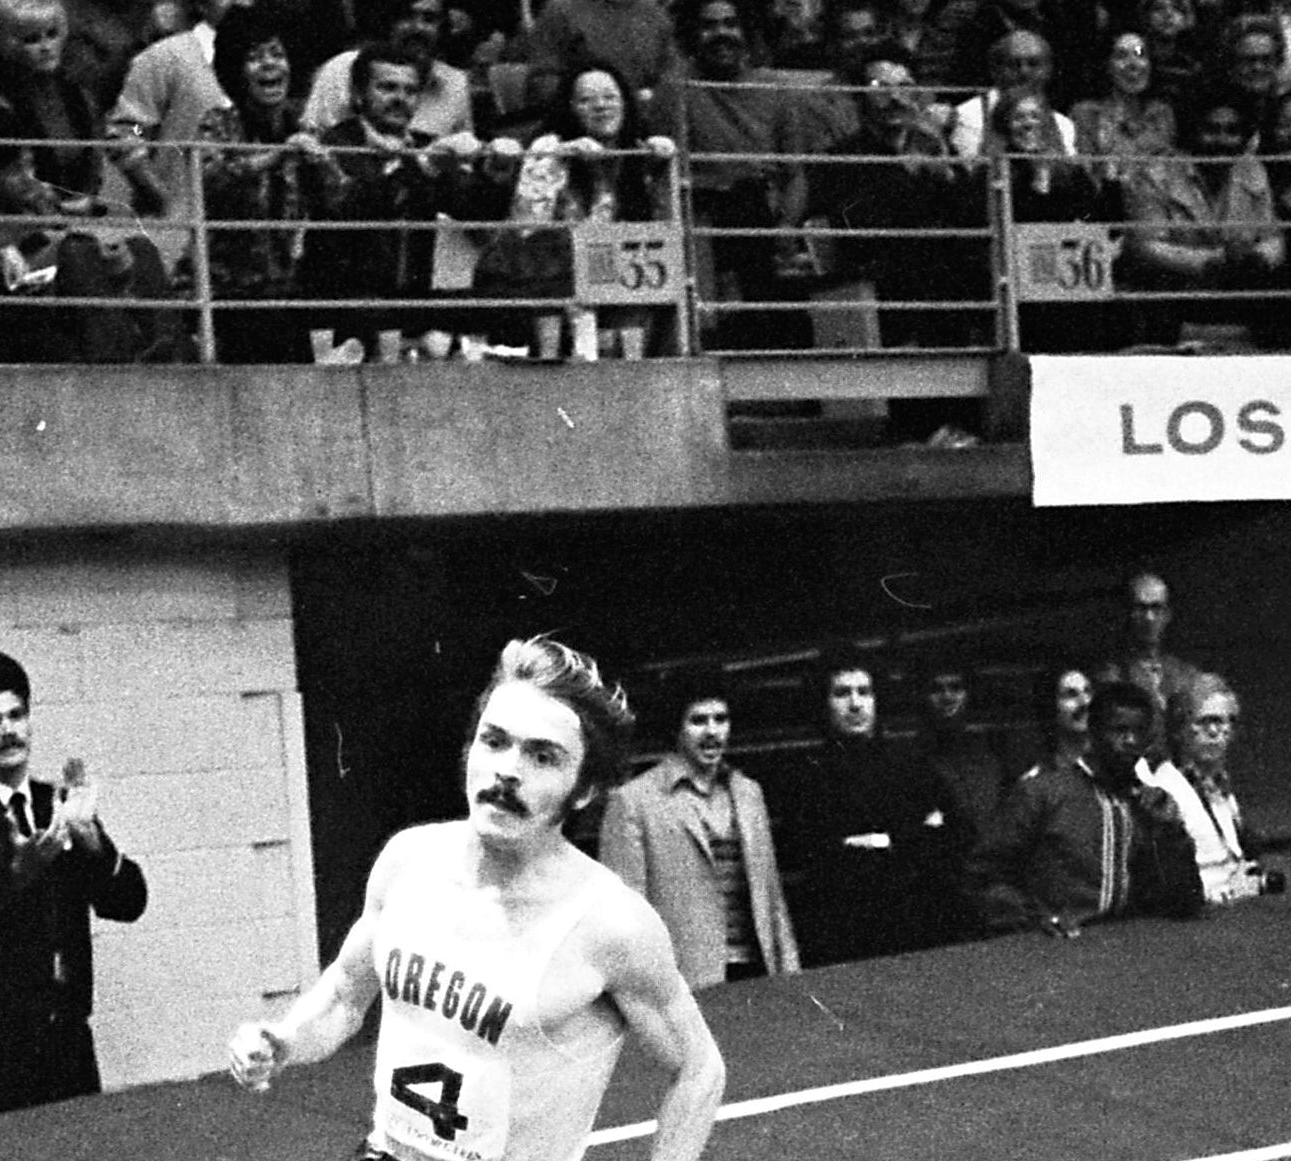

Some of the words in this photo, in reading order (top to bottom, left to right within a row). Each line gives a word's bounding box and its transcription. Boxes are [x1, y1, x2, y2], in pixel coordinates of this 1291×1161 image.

[1057, 240, 1104, 291] 36
[1119, 399, 1286, 455] LOS
[384, 947, 513, 1048] OREGON
[390, 1062, 469, 1142] 4
